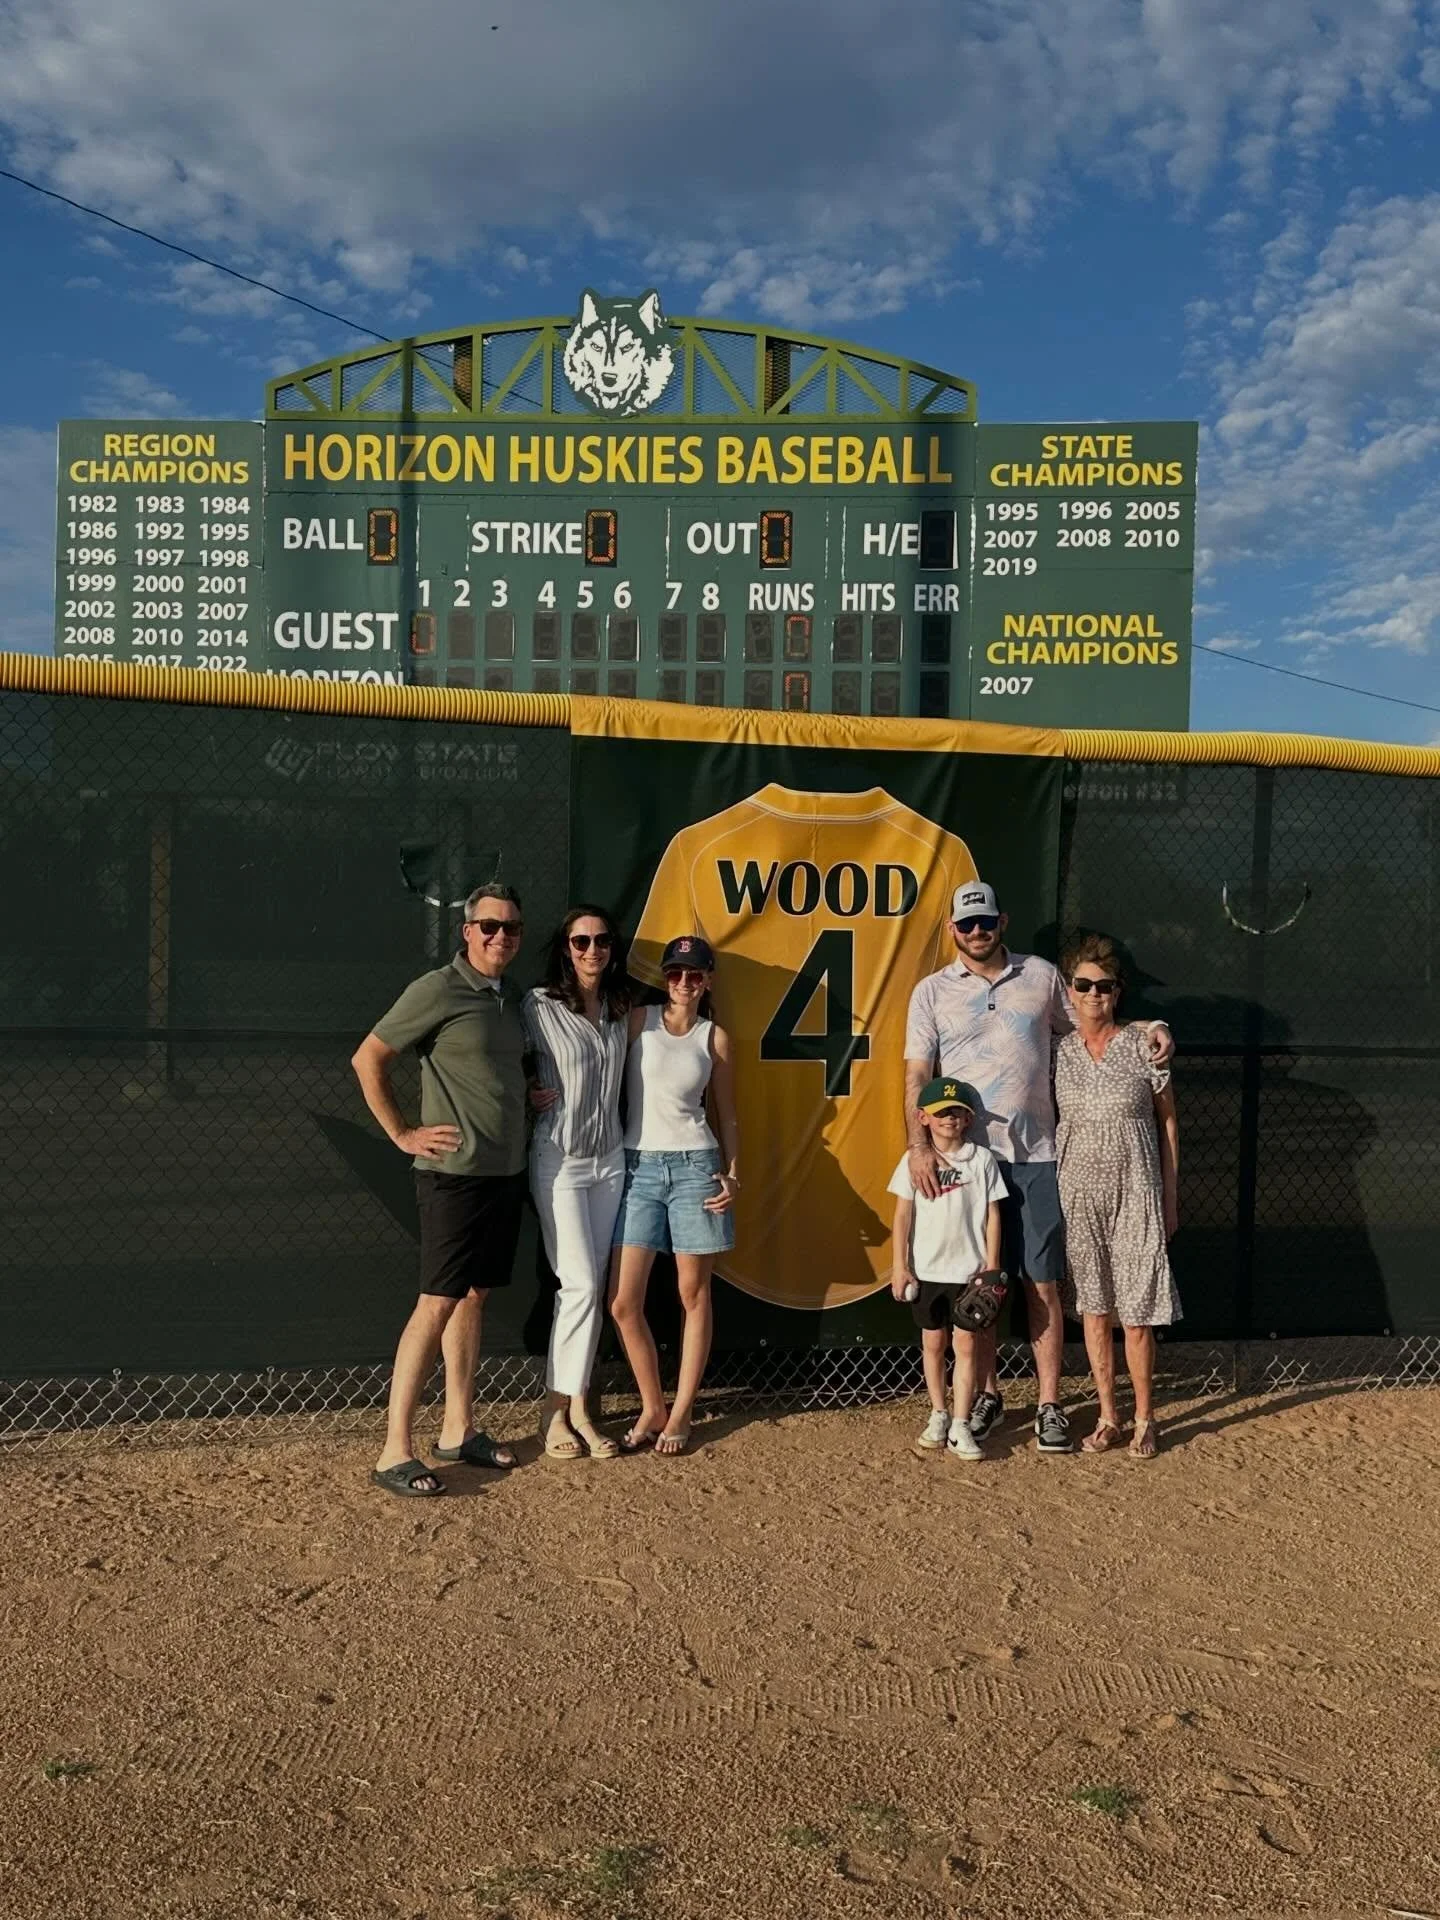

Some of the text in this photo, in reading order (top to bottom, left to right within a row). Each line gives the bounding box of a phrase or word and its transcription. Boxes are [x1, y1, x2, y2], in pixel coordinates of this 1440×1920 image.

[105, 434, 214, 458] REGION
[1042, 436, 1132, 458] STATE
[285, 434, 951, 484] HORIZON HUSKIES BASEBALL
[70, 461, 248, 483] CHAMPIONS
[991, 463, 1182, 486] CHAMPIONS
[68, 495, 250, 514] 1982 1983 1984
[986, 502, 1180, 520] 1995 1996 2005
[68, 522, 249, 540] 1986 1992 1995
[284, 518, 363, 550] BALL
[472, 522, 582, 554] STRIKE
[687, 522, 757, 554] OUT
[864, 523, 918, 556] H/E
[984, 529, 1179, 548] 2007 2008 2010
[67, 548, 249, 567] 1996 1997 1998
[983, 558, 1037, 575] 2019
[67, 574, 246, 594] 1999 2000 2001
[419, 579, 959, 612] 1 2 3 4 5 6 7 8 RUNS HITS ERR
[65, 600, 248, 620] 2002 2003 2007
[64, 627, 248, 646] 2008 2010 2014
[274, 611, 398, 650] GUEST
[1005, 615, 1162, 637] NATIONAL
[197, 655, 248, 672] 2022
[987, 642, 1178, 664] CHAMPIONS
[980, 677, 1033, 694] 2007
[715, 858, 920, 920] WOOD
[760, 928, 871, 1098] 4
[936, 1169, 962, 1187] IKE
